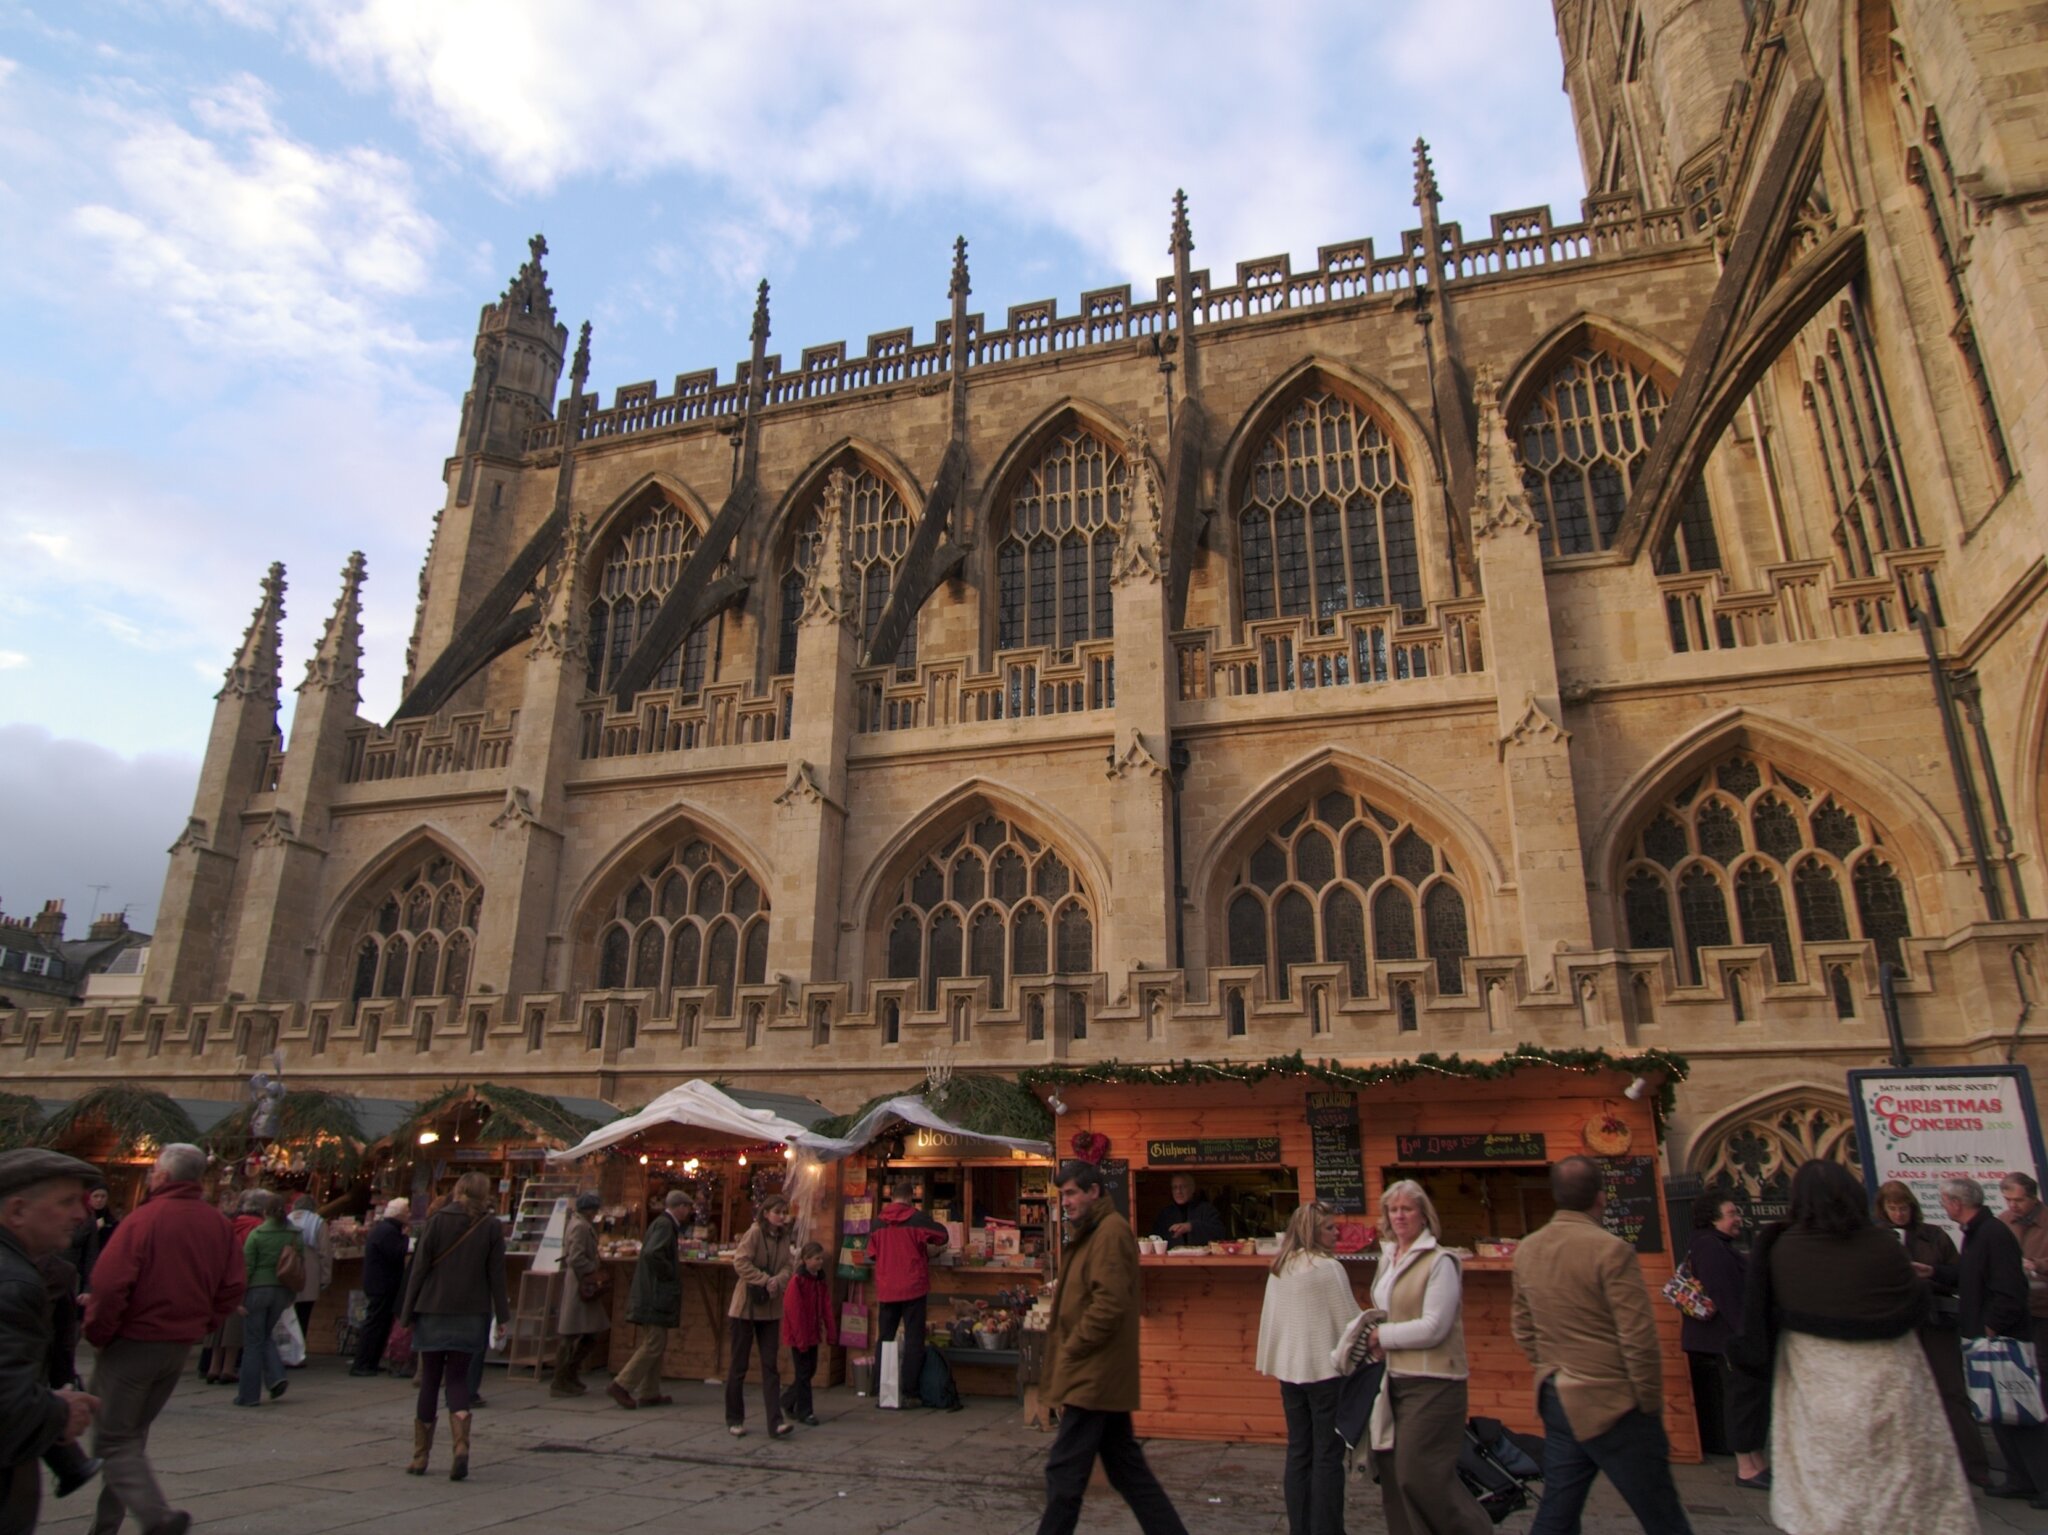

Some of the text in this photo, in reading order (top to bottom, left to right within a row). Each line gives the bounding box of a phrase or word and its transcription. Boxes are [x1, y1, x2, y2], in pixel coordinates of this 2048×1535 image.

[1904, 1084, 1931, 1092] ABBEY
[1965, 1083, 1998, 1091] SOCIETY
[1875, 1095, 2002, 1119] CHRISTMAS
[1889, 1114, 1983, 1138] CONCERTS
[1150, 1142, 1197, 1157] Glühwein
[1898, 1152, 1952, 1164] December
[1887, 1170, 1927, 1179] CAROLS
[1940, 1171, 1969, 1179] CHOIR
[1751, 1205, 1787, 1216] HERIT
